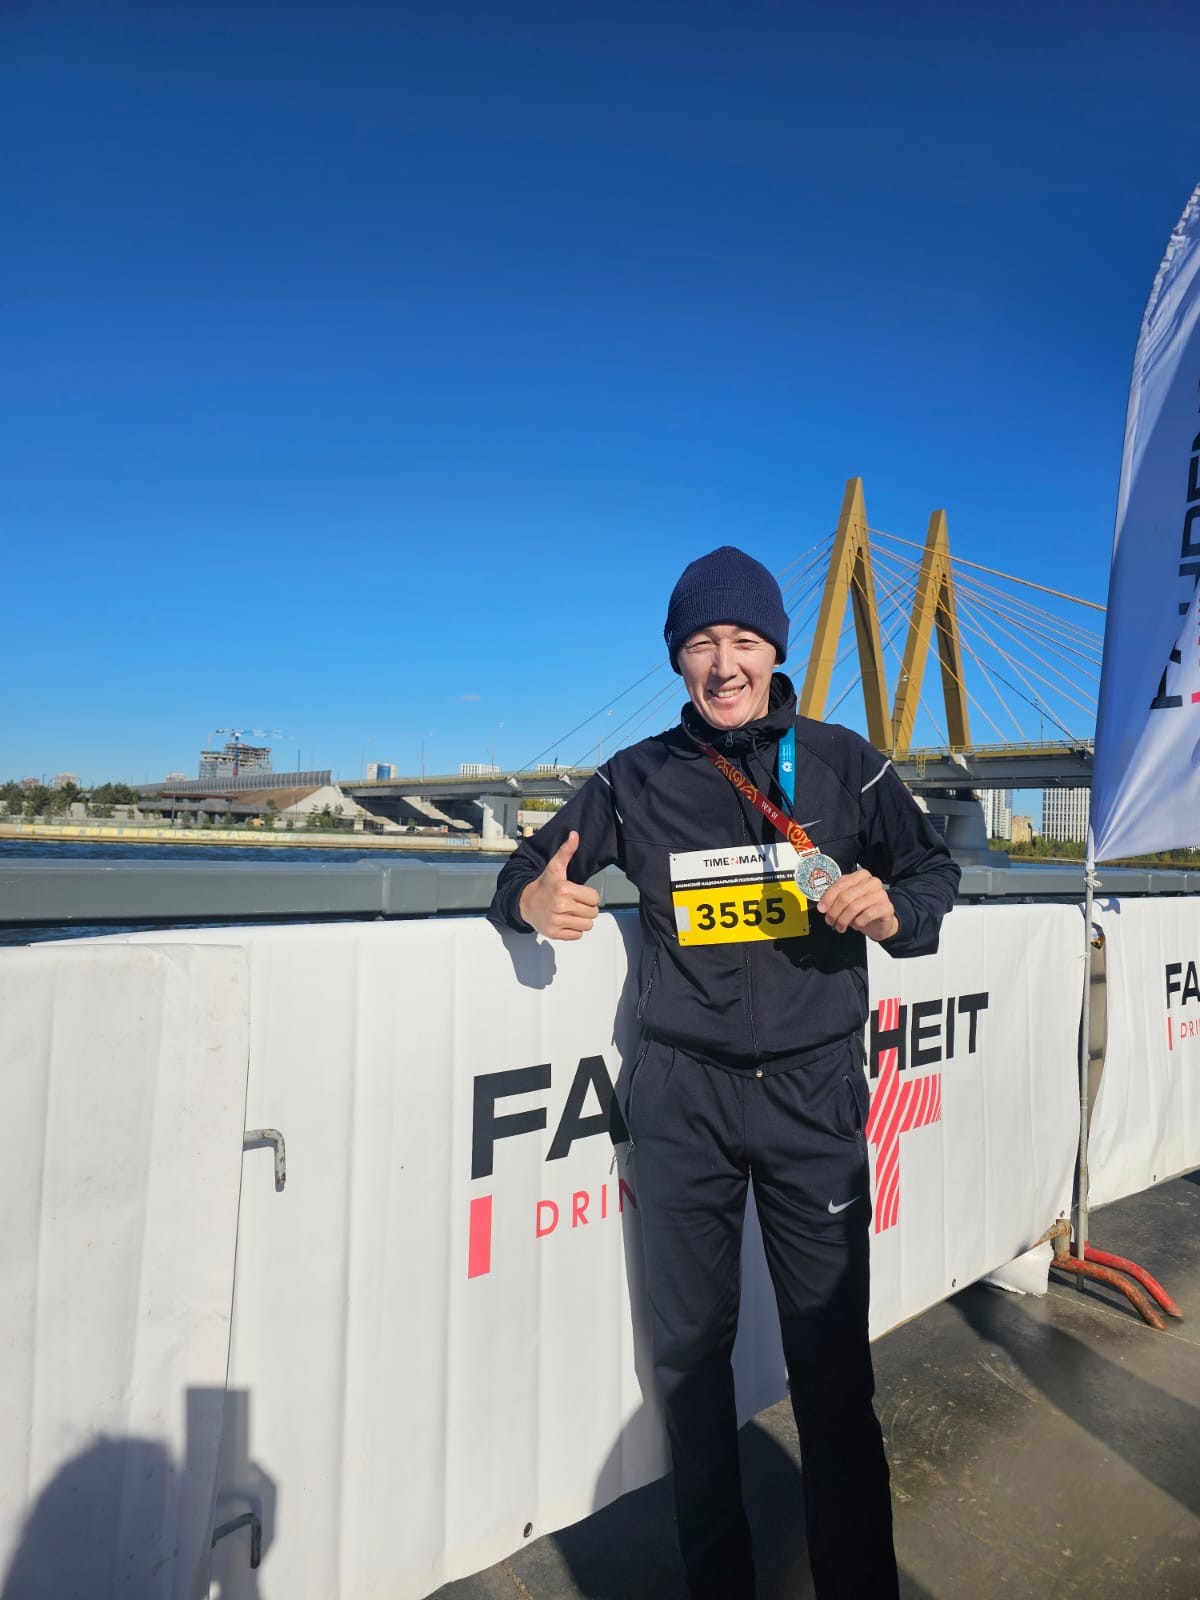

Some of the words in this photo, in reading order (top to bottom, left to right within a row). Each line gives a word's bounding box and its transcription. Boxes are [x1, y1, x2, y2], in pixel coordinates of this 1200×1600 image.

[696, 897, 786, 931] 3555
[1180, 1017, 1200, 1039] DRI
[536, 1178, 637, 1239] DRIN
